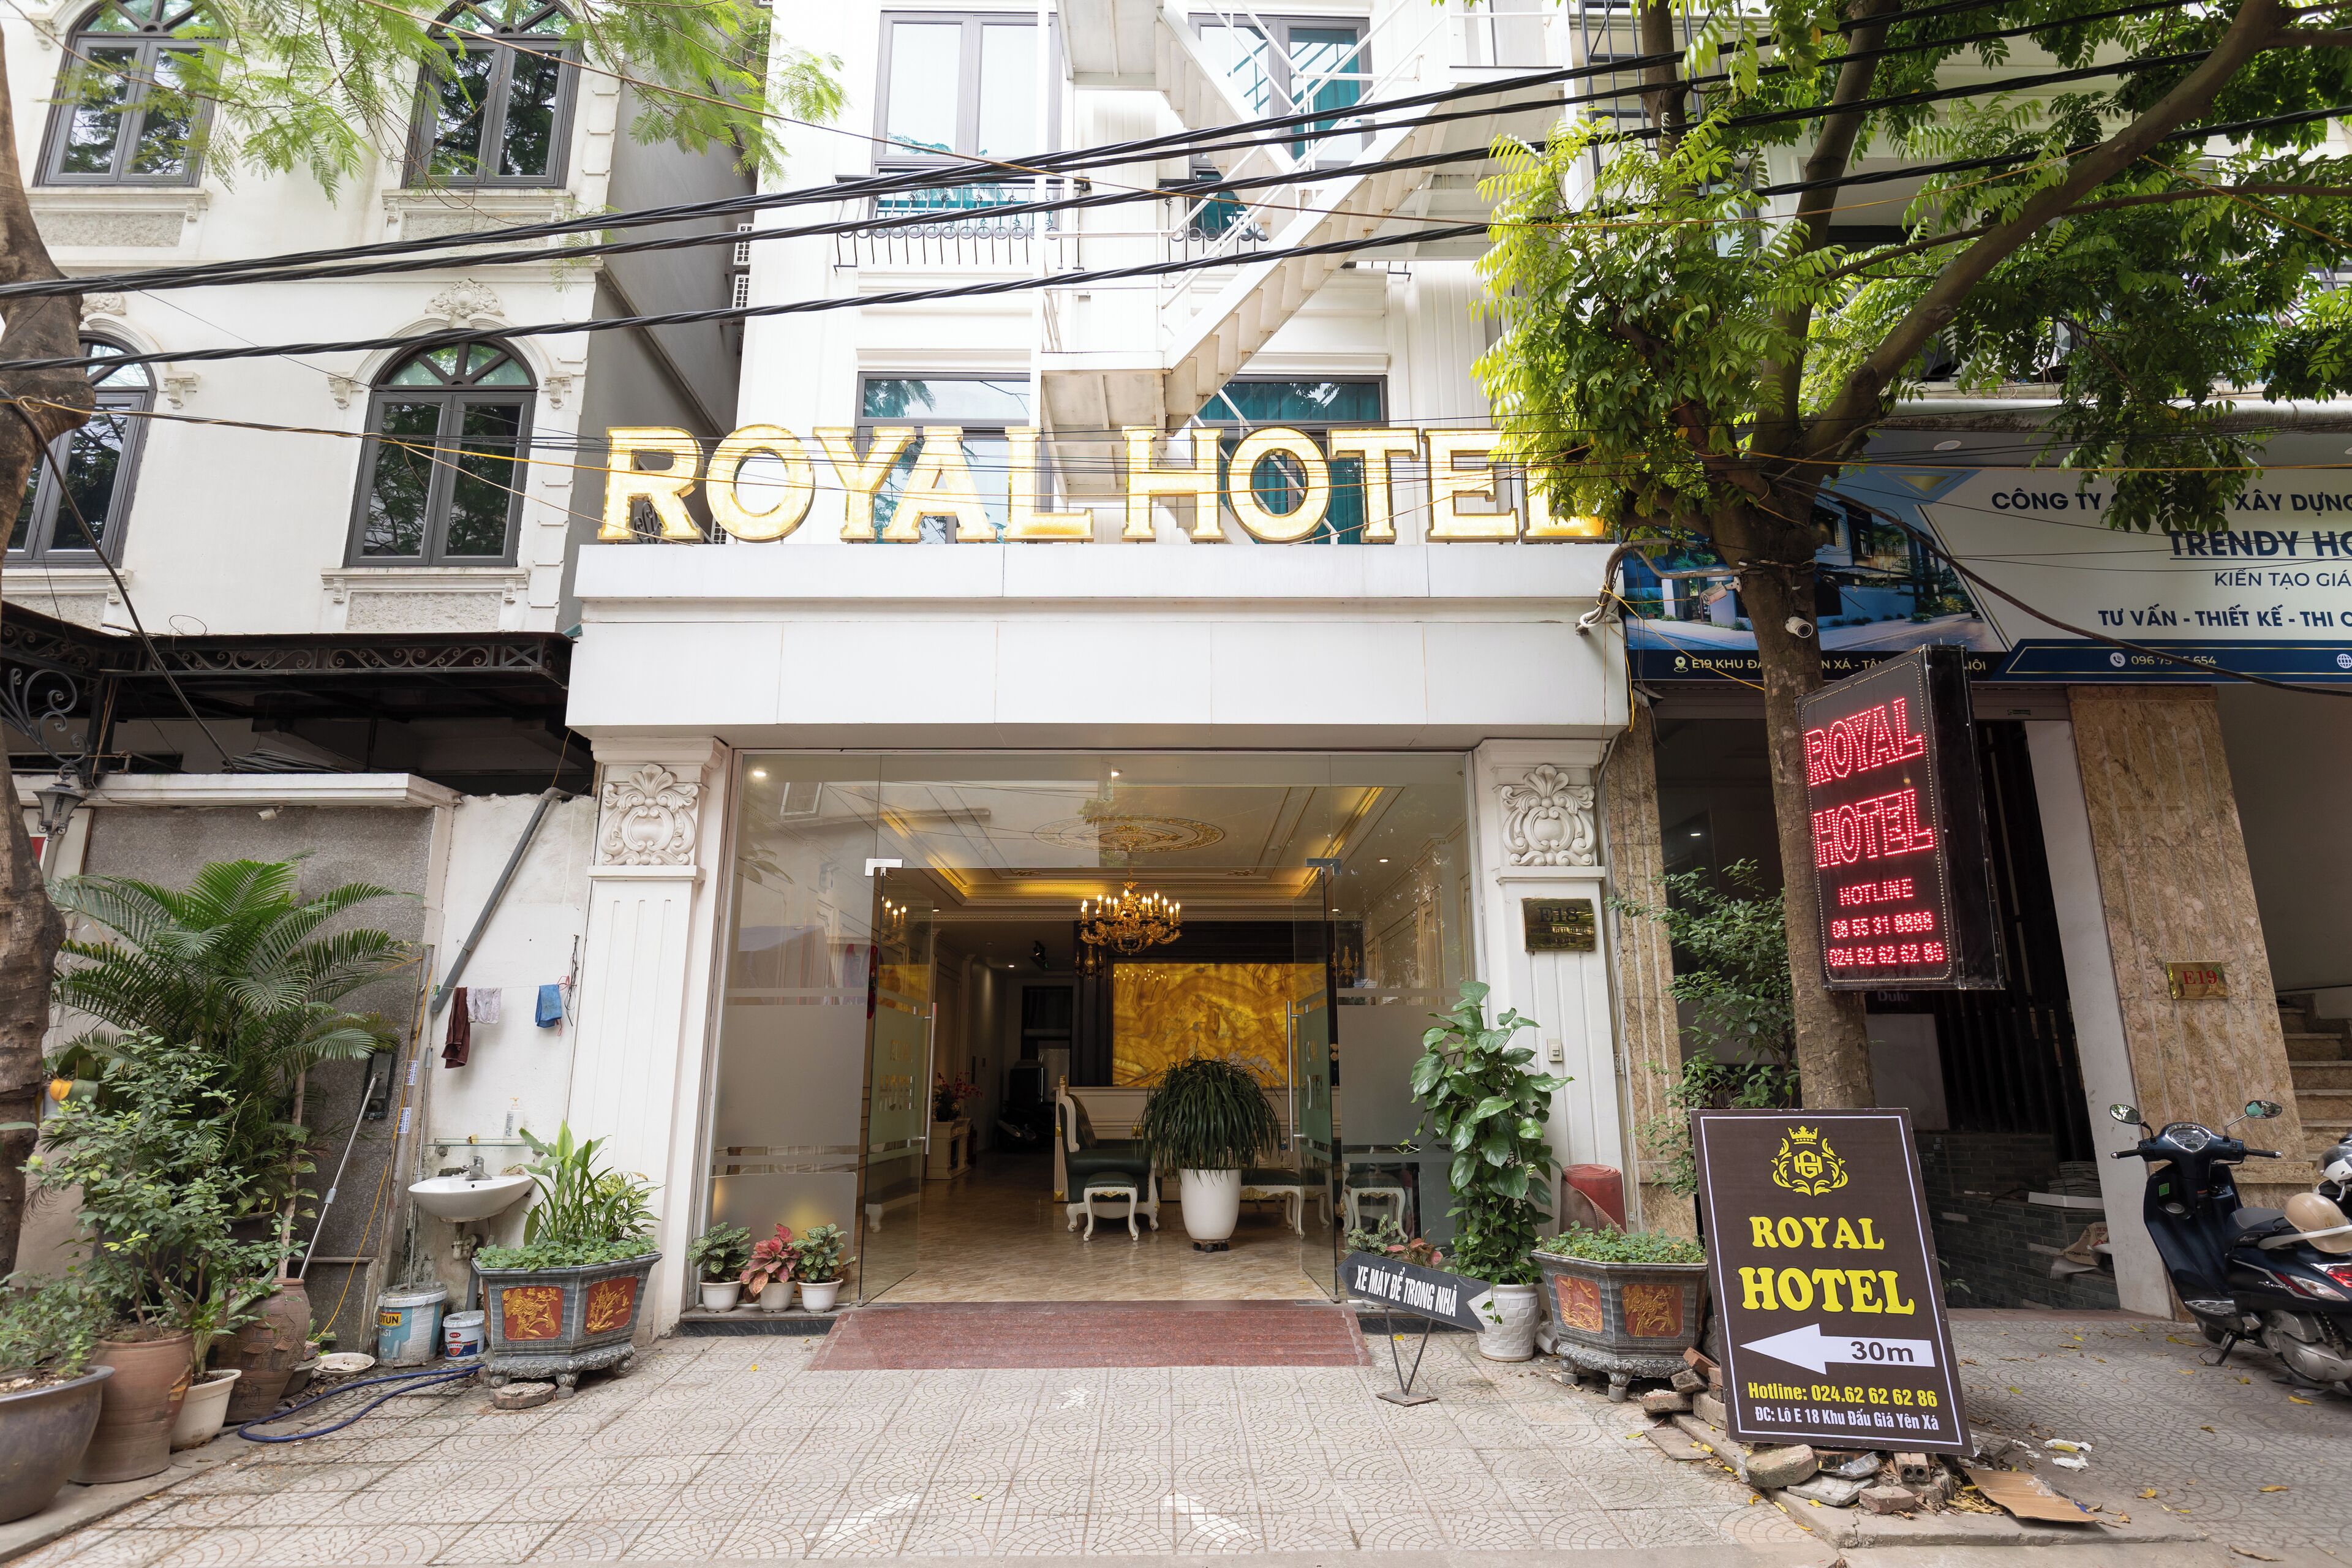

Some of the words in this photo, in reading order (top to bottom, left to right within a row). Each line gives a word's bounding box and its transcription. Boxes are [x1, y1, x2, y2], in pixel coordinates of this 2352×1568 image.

[597, 424, 1094, 543] ROYAL
[1120, 424, 1615, 544] HOTEL
[1992, 488, 2069, 511] CÔNG
[2074, 492, 2102, 510] TY
[2234, 488, 2282, 511] XÂY
[2169, 530, 2299, 556] TRENDY
[2215, 568, 2261, 586] KIẾN
[2268, 573, 2310, 590] TẠO
[2316, 570, 2351, 587] GIÁ
[2098, 608, 2124, 625] TƯ
[2130, 603, 2177, 626] VẤN
[2195, 604, 2249, 626] THIẾT
[2257, 605, 2283, 627] KẾ
[2299, 611, 2334, 627] THI
[1716, 659, 1743, 668] KHU
[1834, 658, 1852, 669] XÁ
[2131, 655, 2155, 665] 096
[2193, 655, 2217, 665] 654
[1805, 697, 1924, 786] ROYAL
[1812, 788, 1934, 869] HOTEL
[1839, 878, 1913, 907] HOTLINE
[1538, 907, 1578, 922] E18
[1832, 920, 1849, 938] 08
[1852, 918, 1869, 937] 55
[1872, 916, 1890, 935] 31
[1894, 911, 1934, 933] 8888
[1829, 947, 1855, 966] 024
[1857, 947, 1875, 965] 62
[1879, 945, 1898, 964] 62
[1901, 944, 1920, 963] 62
[1923, 942, 1943, 962] 86
[2182, 970, 2217, 985] E19
[1749, 1216, 1885, 1250] ROYAL
[1354, 1265, 1369, 1292] XE
[1368, 1266, 1391, 1297] MÁY
[1389, 1266, 1406, 1302] ĐỂ
[1403, 1277, 1435, 1311] TRONG
[1434, 1284, 1457, 1317] NHÀ
[1738, 1266, 1915, 1315] HOTEL
[1850, 1341, 1915, 1363] 30m
[1747, 1382, 1807, 1401] Hotline:
[1811, 1384, 1865, 1403] 024.62
[1868, 1387, 1889, 1404] 62
[1892, 1389, 1914, 1406] 62
[1917, 1390, 1938, 1408] 86
[1755, 1406, 1775, 1422] ĐC:
[1777, 1407, 1792, 1422] Lô
[1793, 1408, 1803, 1423] E
[1804, 1408, 1820, 1423] 18
[1821, 1409, 1846, 1425] Khu
[1847, 1408, 1872, 1427] Đấu
[1873, 1412, 1894, 1428] Giá
[1896, 1413, 1920, 1430] Yên
[1923, 1414, 1940, 1431] Xá
